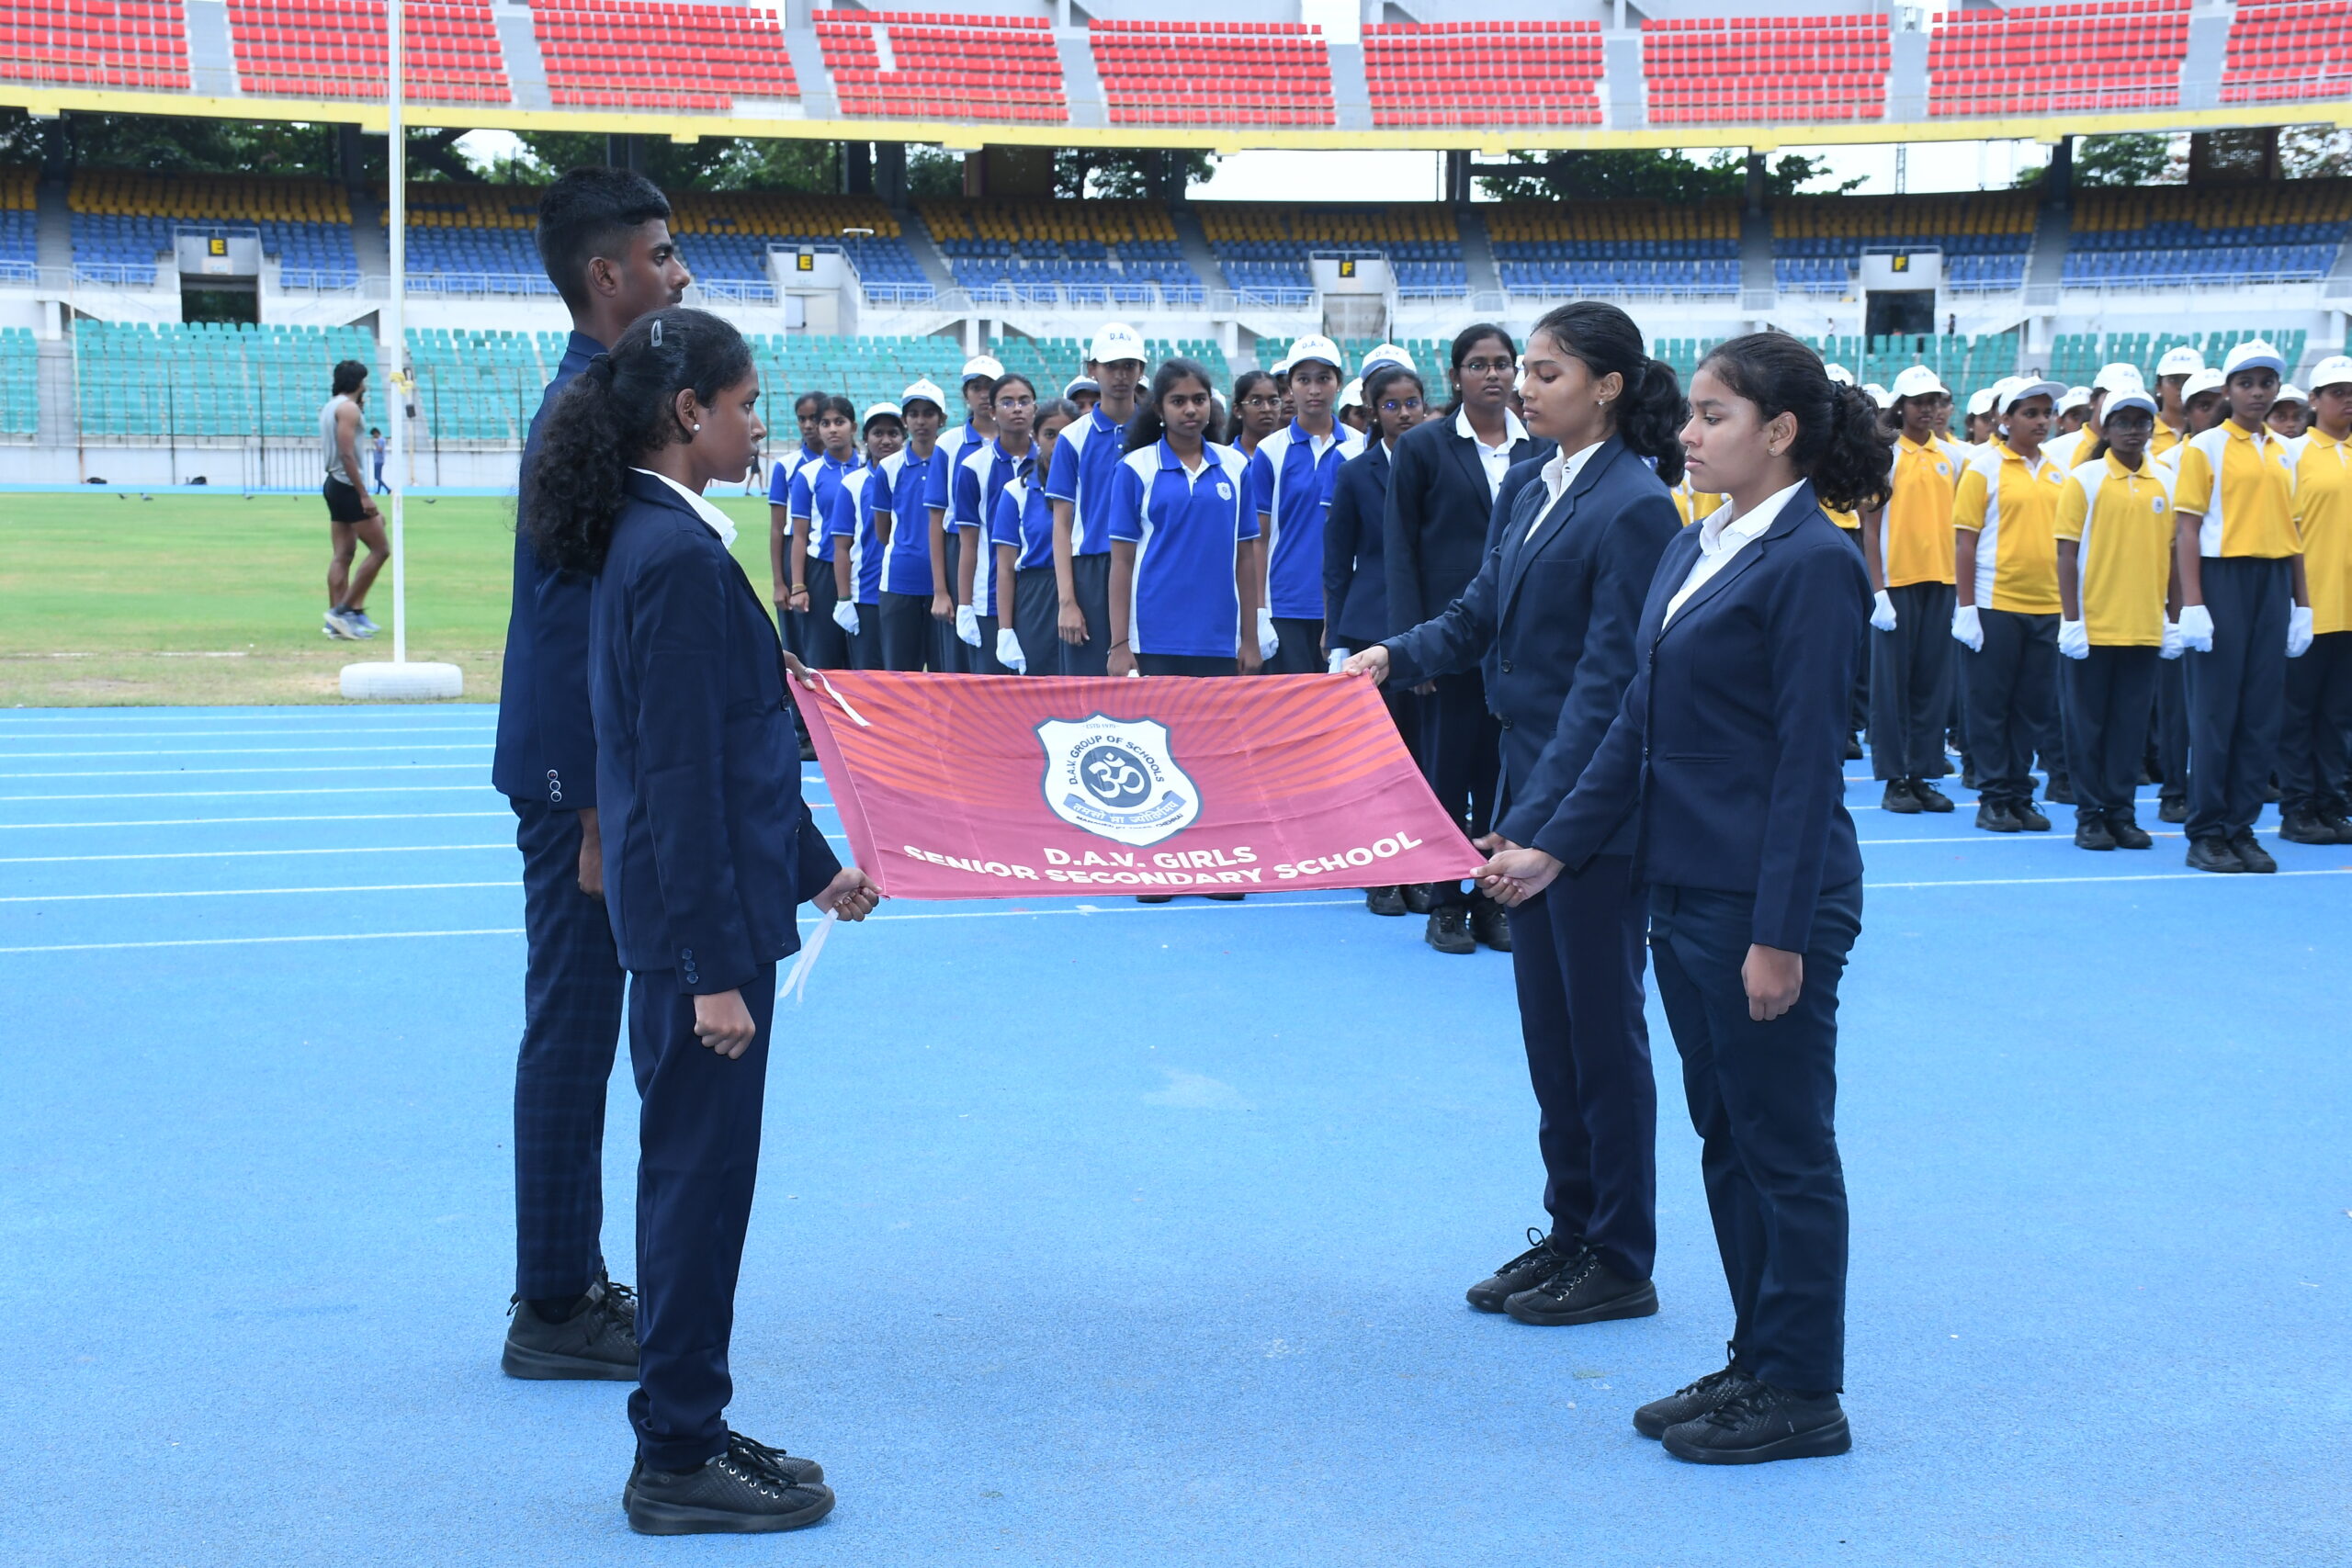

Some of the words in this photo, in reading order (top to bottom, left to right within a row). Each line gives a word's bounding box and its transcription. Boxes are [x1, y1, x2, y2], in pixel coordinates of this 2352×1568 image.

[210, 239, 225, 254] E
[799, 255, 811, 270] E
[1341, 262, 1353, 276] F
[1894, 256, 1906, 271] F
[1069, 735, 1102, 759] GROUP
[1106, 735, 1124, 744] OF
[1125, 741, 1165, 783] SCHOOLS
[903, 844, 1041, 881] SENIOR
[1045, 867, 1262, 886] SECONDARY
[1273, 830, 1423, 880] SCHOOL
[1044, 847, 1146, 867] D.A.V.
[1152, 846, 1258, 869] GIRLS
